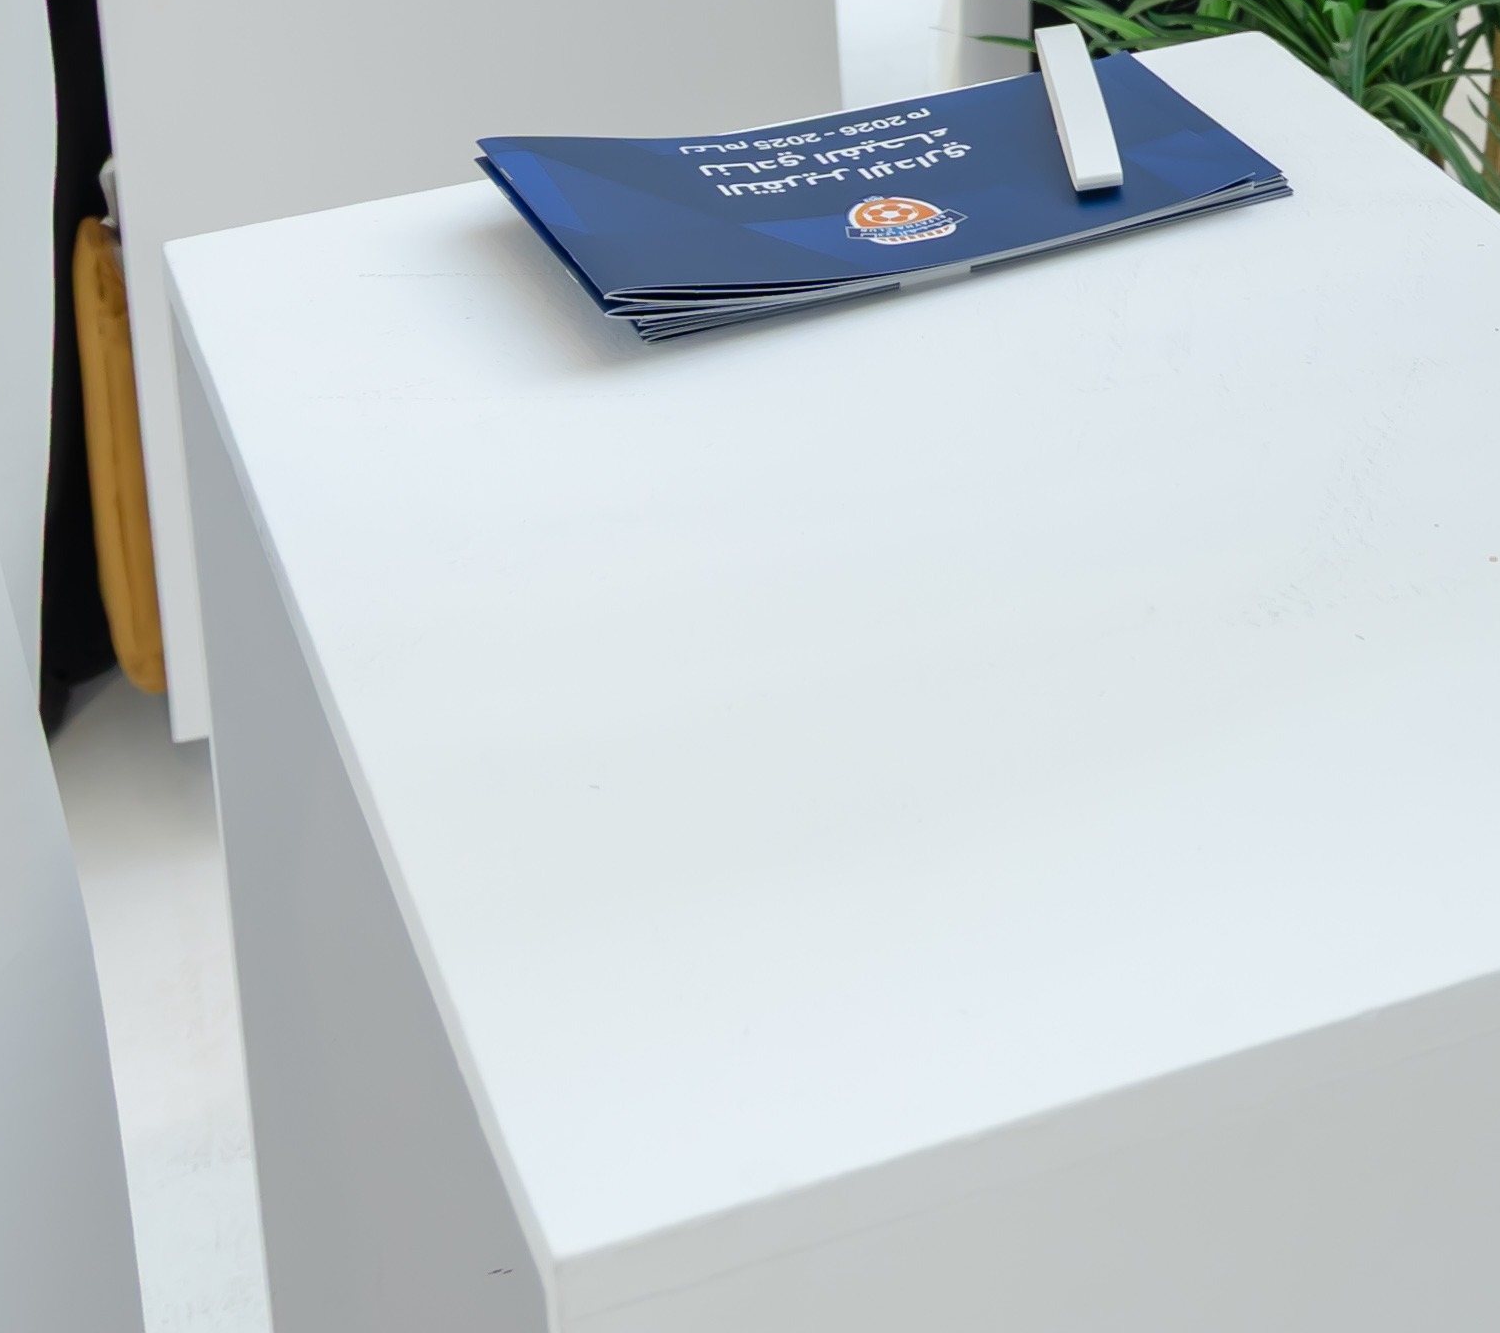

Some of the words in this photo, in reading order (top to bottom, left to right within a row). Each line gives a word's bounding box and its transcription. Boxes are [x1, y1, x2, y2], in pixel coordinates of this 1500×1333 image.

[679, 140, 749, 154] لعام
[752, 132, 822, 150] 2025
[838, 115, 907, 136] 2026
[698, 151, 806, 177] لنادي
[812, 127, 949, 165] الفيحاء
[716, 167, 850, 196] التقرير
[856, 141, 972, 180] الإداري
